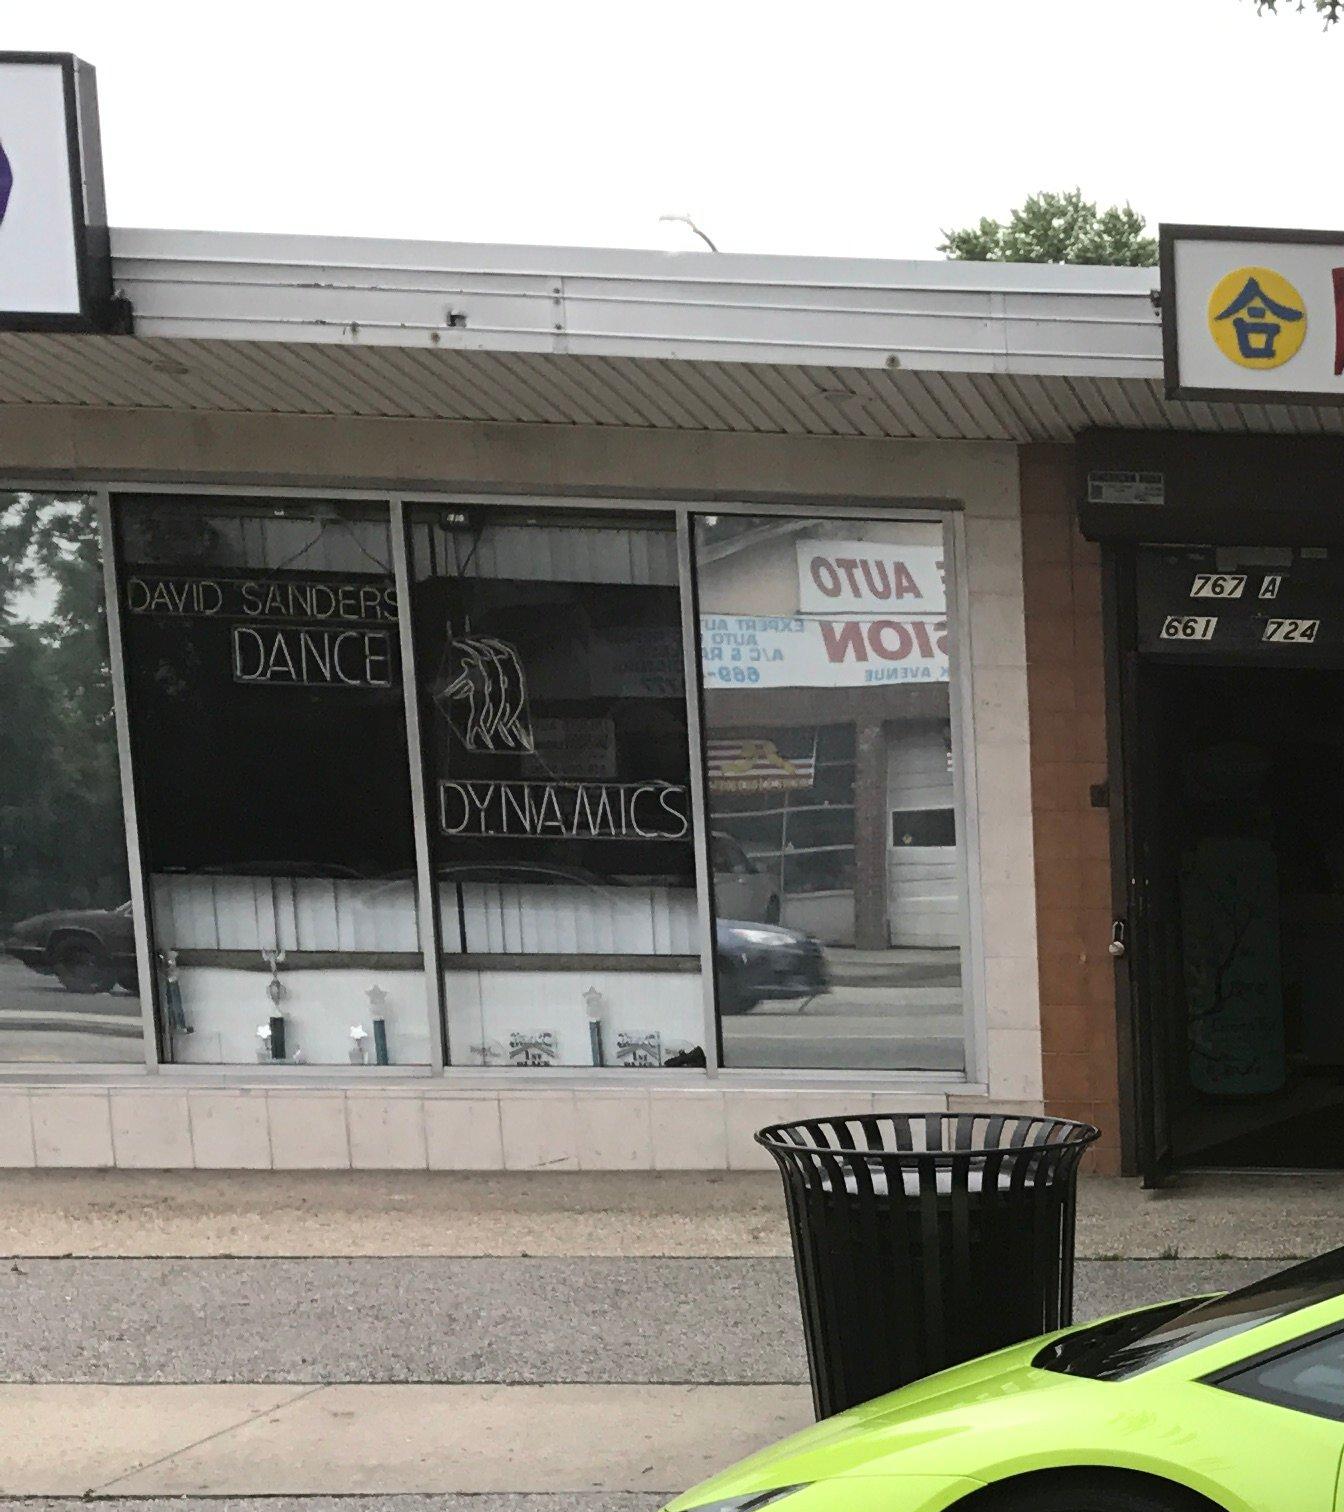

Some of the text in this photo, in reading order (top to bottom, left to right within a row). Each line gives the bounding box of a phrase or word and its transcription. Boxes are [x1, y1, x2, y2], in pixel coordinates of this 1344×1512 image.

[1215, 276, 1304, 359] 合
[126, 576, 399, 622] DAVID SANDERS
[1193, 575, 1278, 598] 767 A
[1163, 617, 1317, 641] 661 724
[233, 626, 390, 686] DANCE
[439, 781, 689, 838] DYNAMICS
